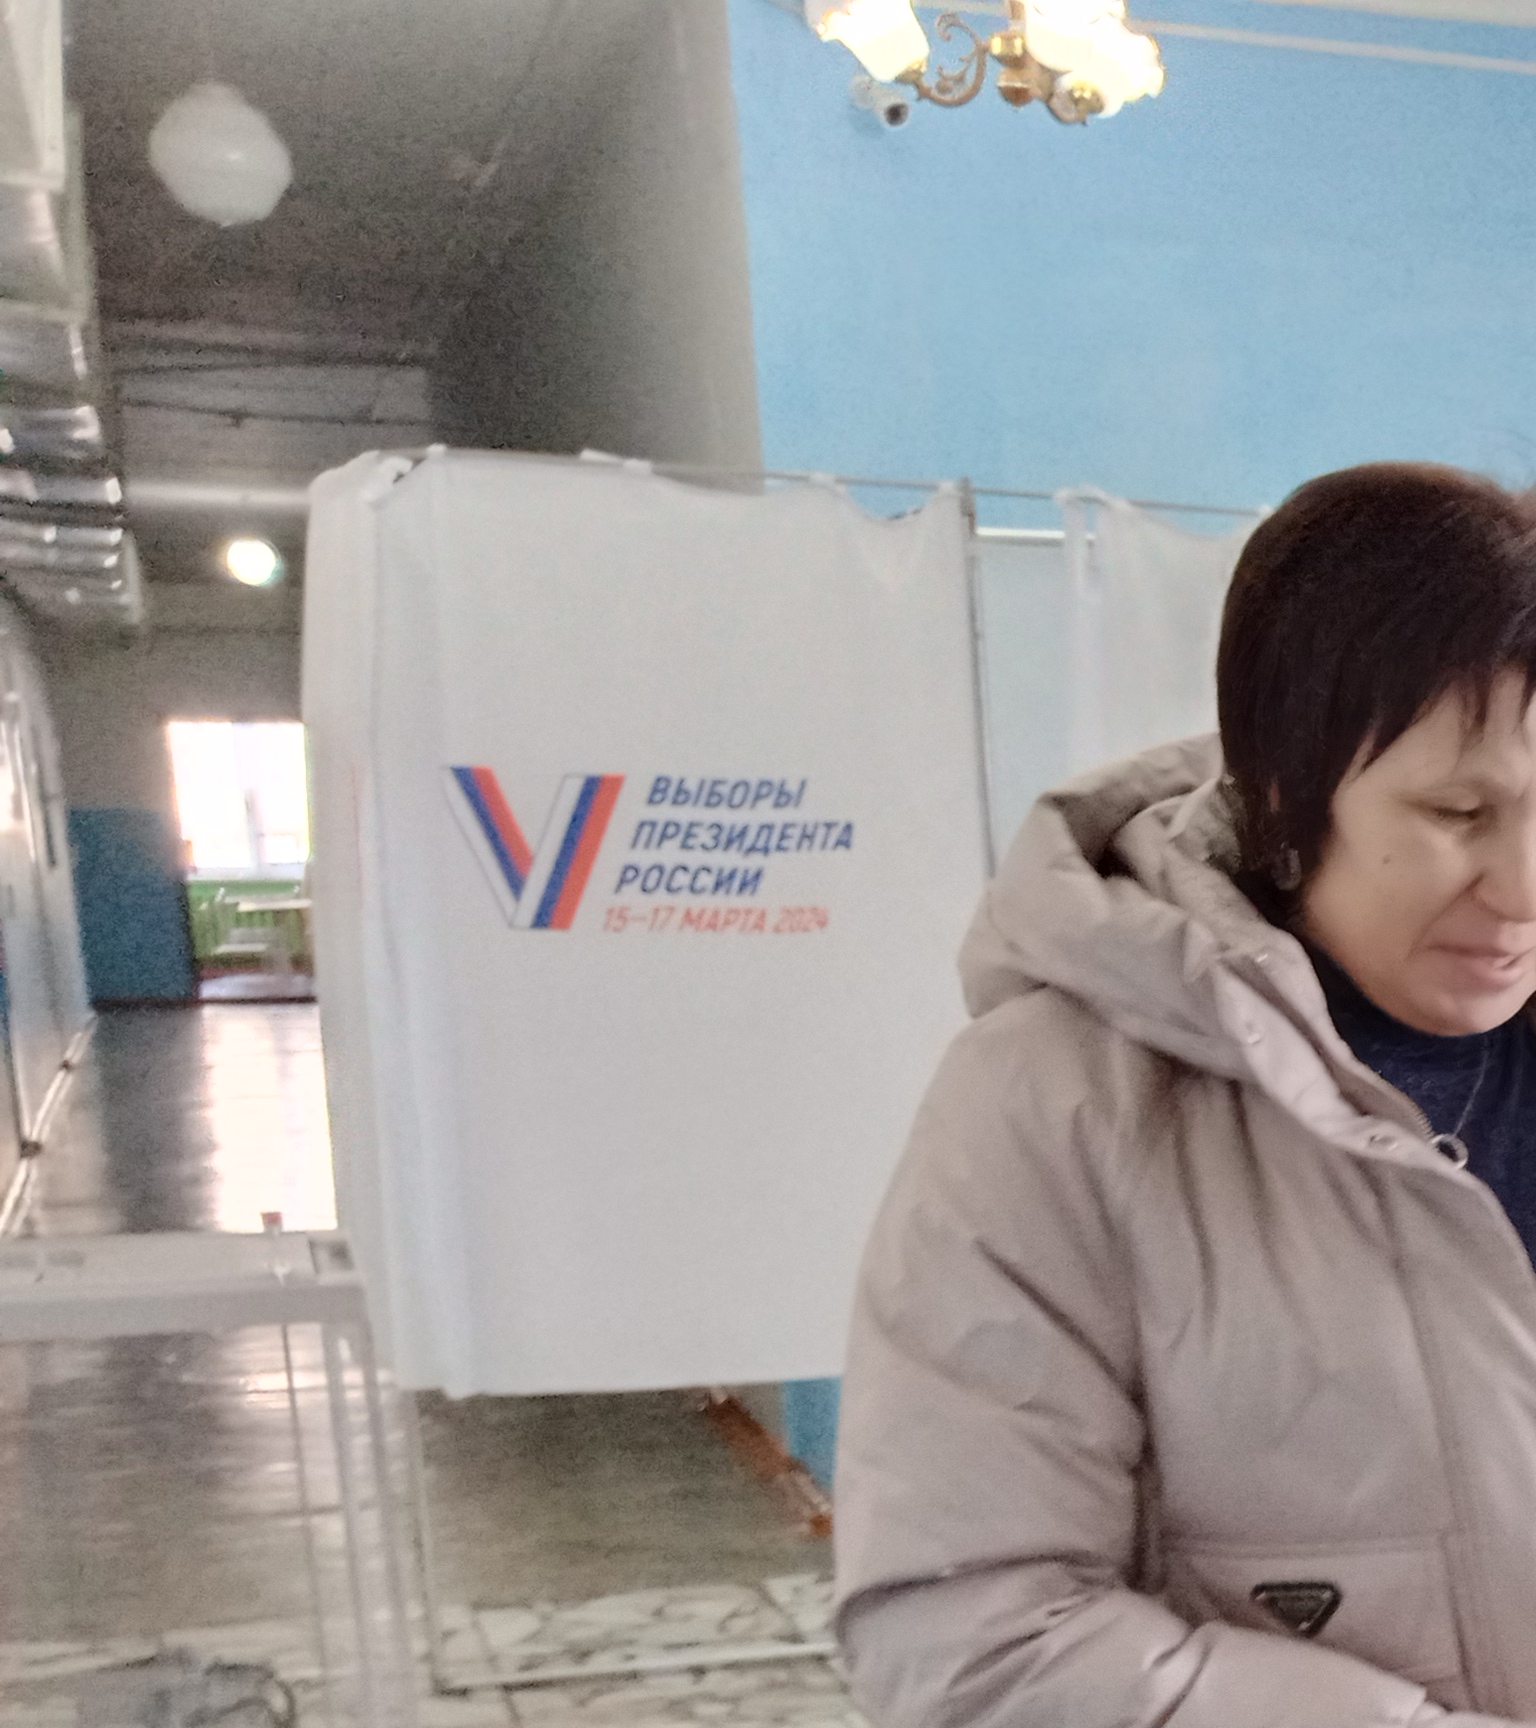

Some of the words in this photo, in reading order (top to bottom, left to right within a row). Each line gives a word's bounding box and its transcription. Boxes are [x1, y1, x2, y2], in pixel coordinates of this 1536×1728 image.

[647, 775, 808, 809] ВЫБОРЫ
[630, 820, 855, 856] ПРЕЗИДЕНТА
[615, 863, 764, 896] РОССИИ
[679, 905, 767, 933] МАРТА
